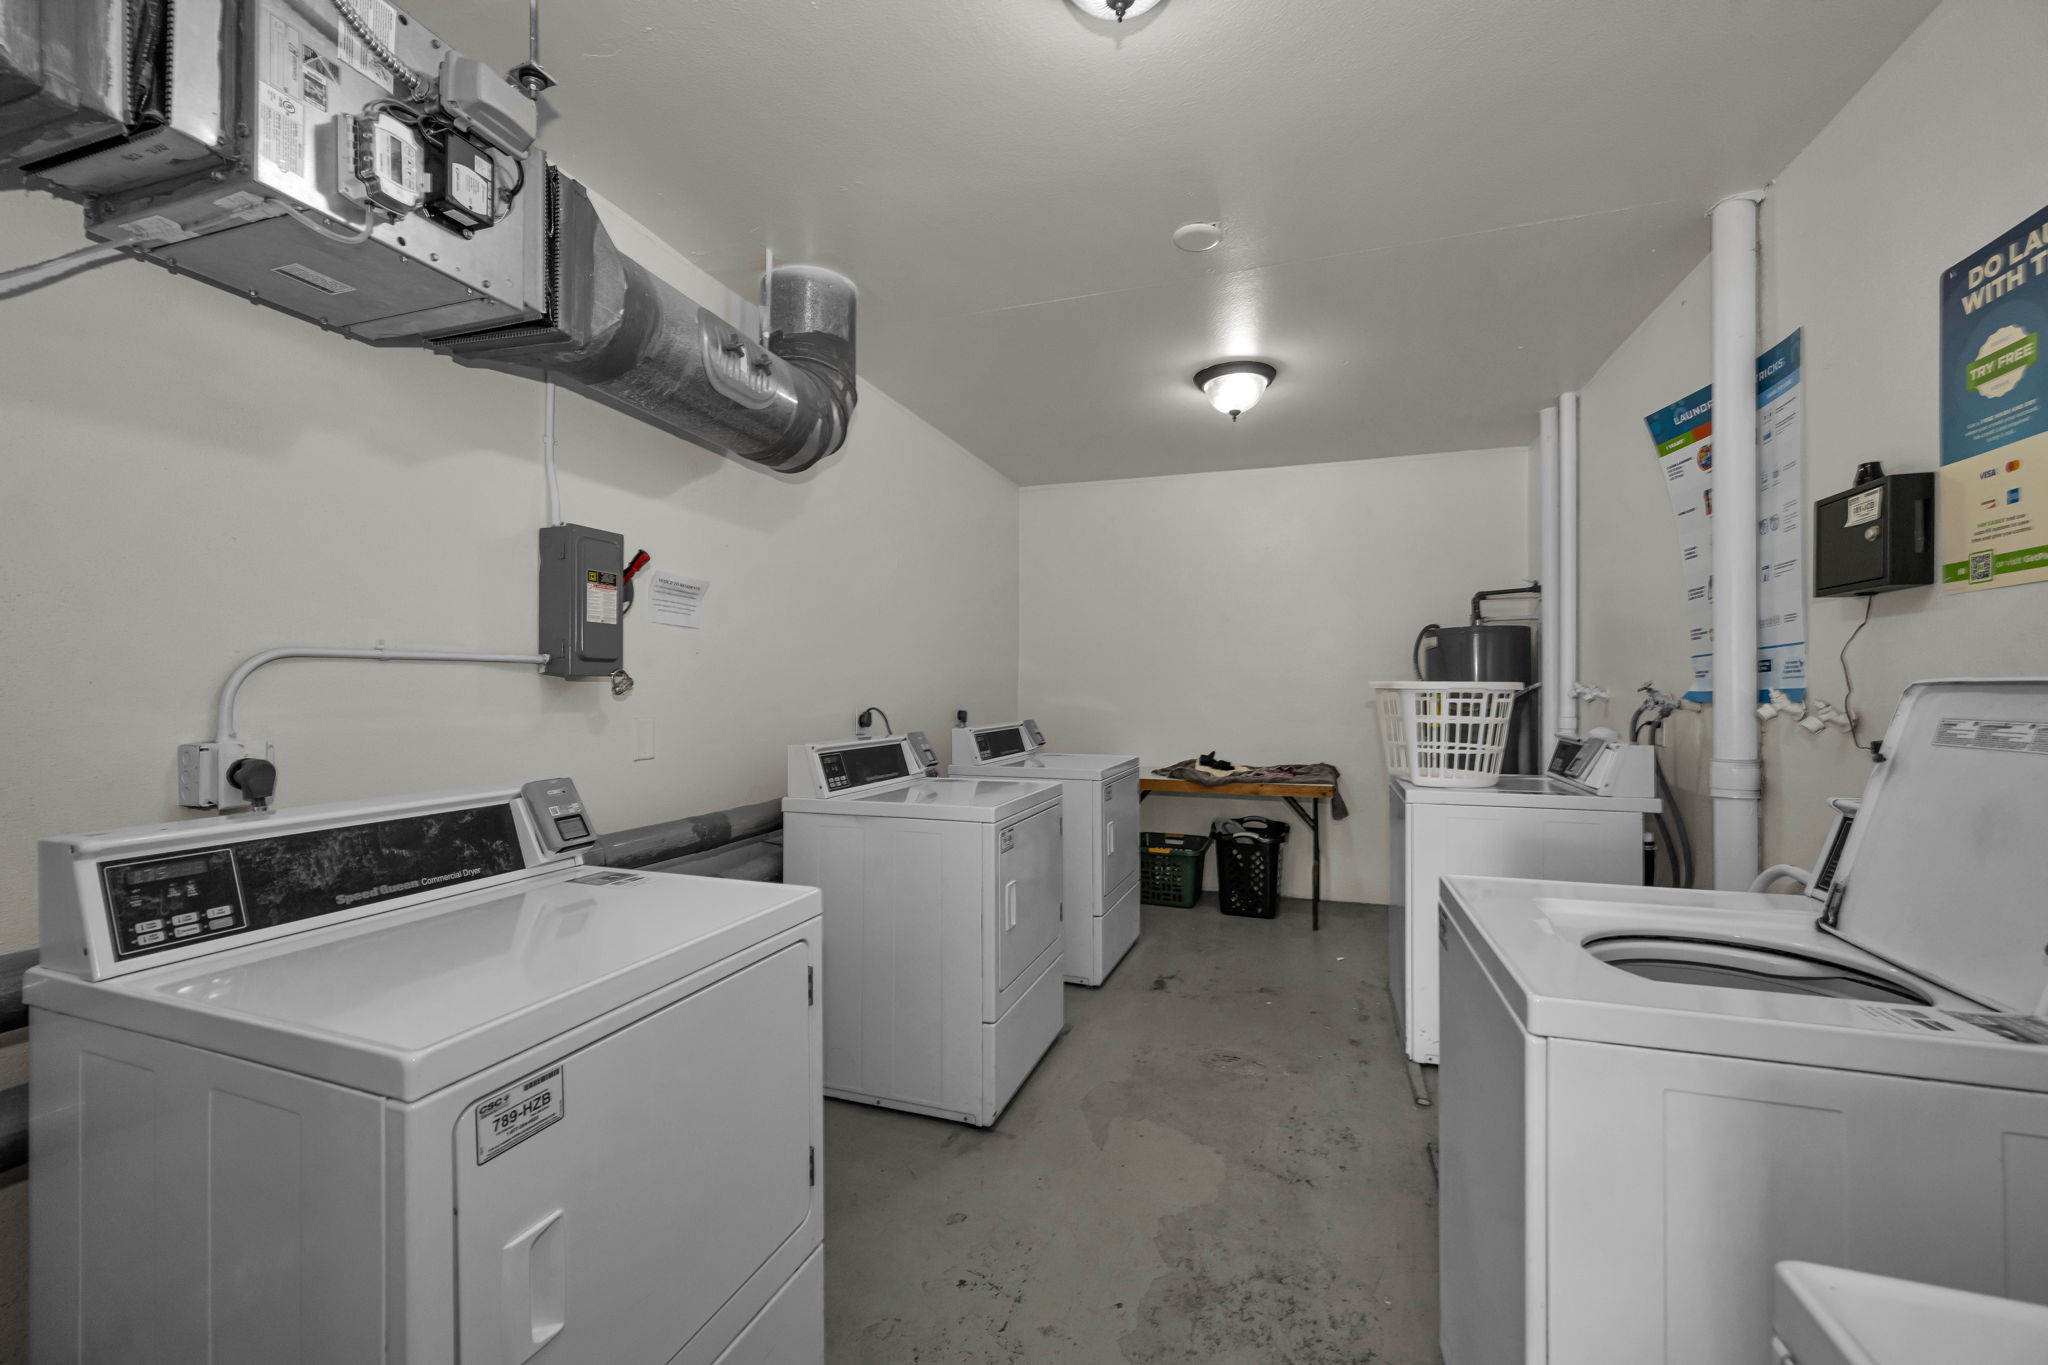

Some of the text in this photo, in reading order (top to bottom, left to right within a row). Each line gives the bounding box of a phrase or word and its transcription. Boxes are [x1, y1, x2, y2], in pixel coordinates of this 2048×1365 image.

[1961, 262, 2025, 315] WITH
[1968, 254, 2003, 290] DO
[1756, 357, 1785, 381] RICKS
[1970, 342, 2034, 381] TRY FREE
[1980, 469, 1997, 480] VISA
[335, 867, 481, 905] Speed Queen Commercial Dryer
[479, 1097, 502, 1115] CSC
[492, 1091, 551, 1132] 789-HZB
